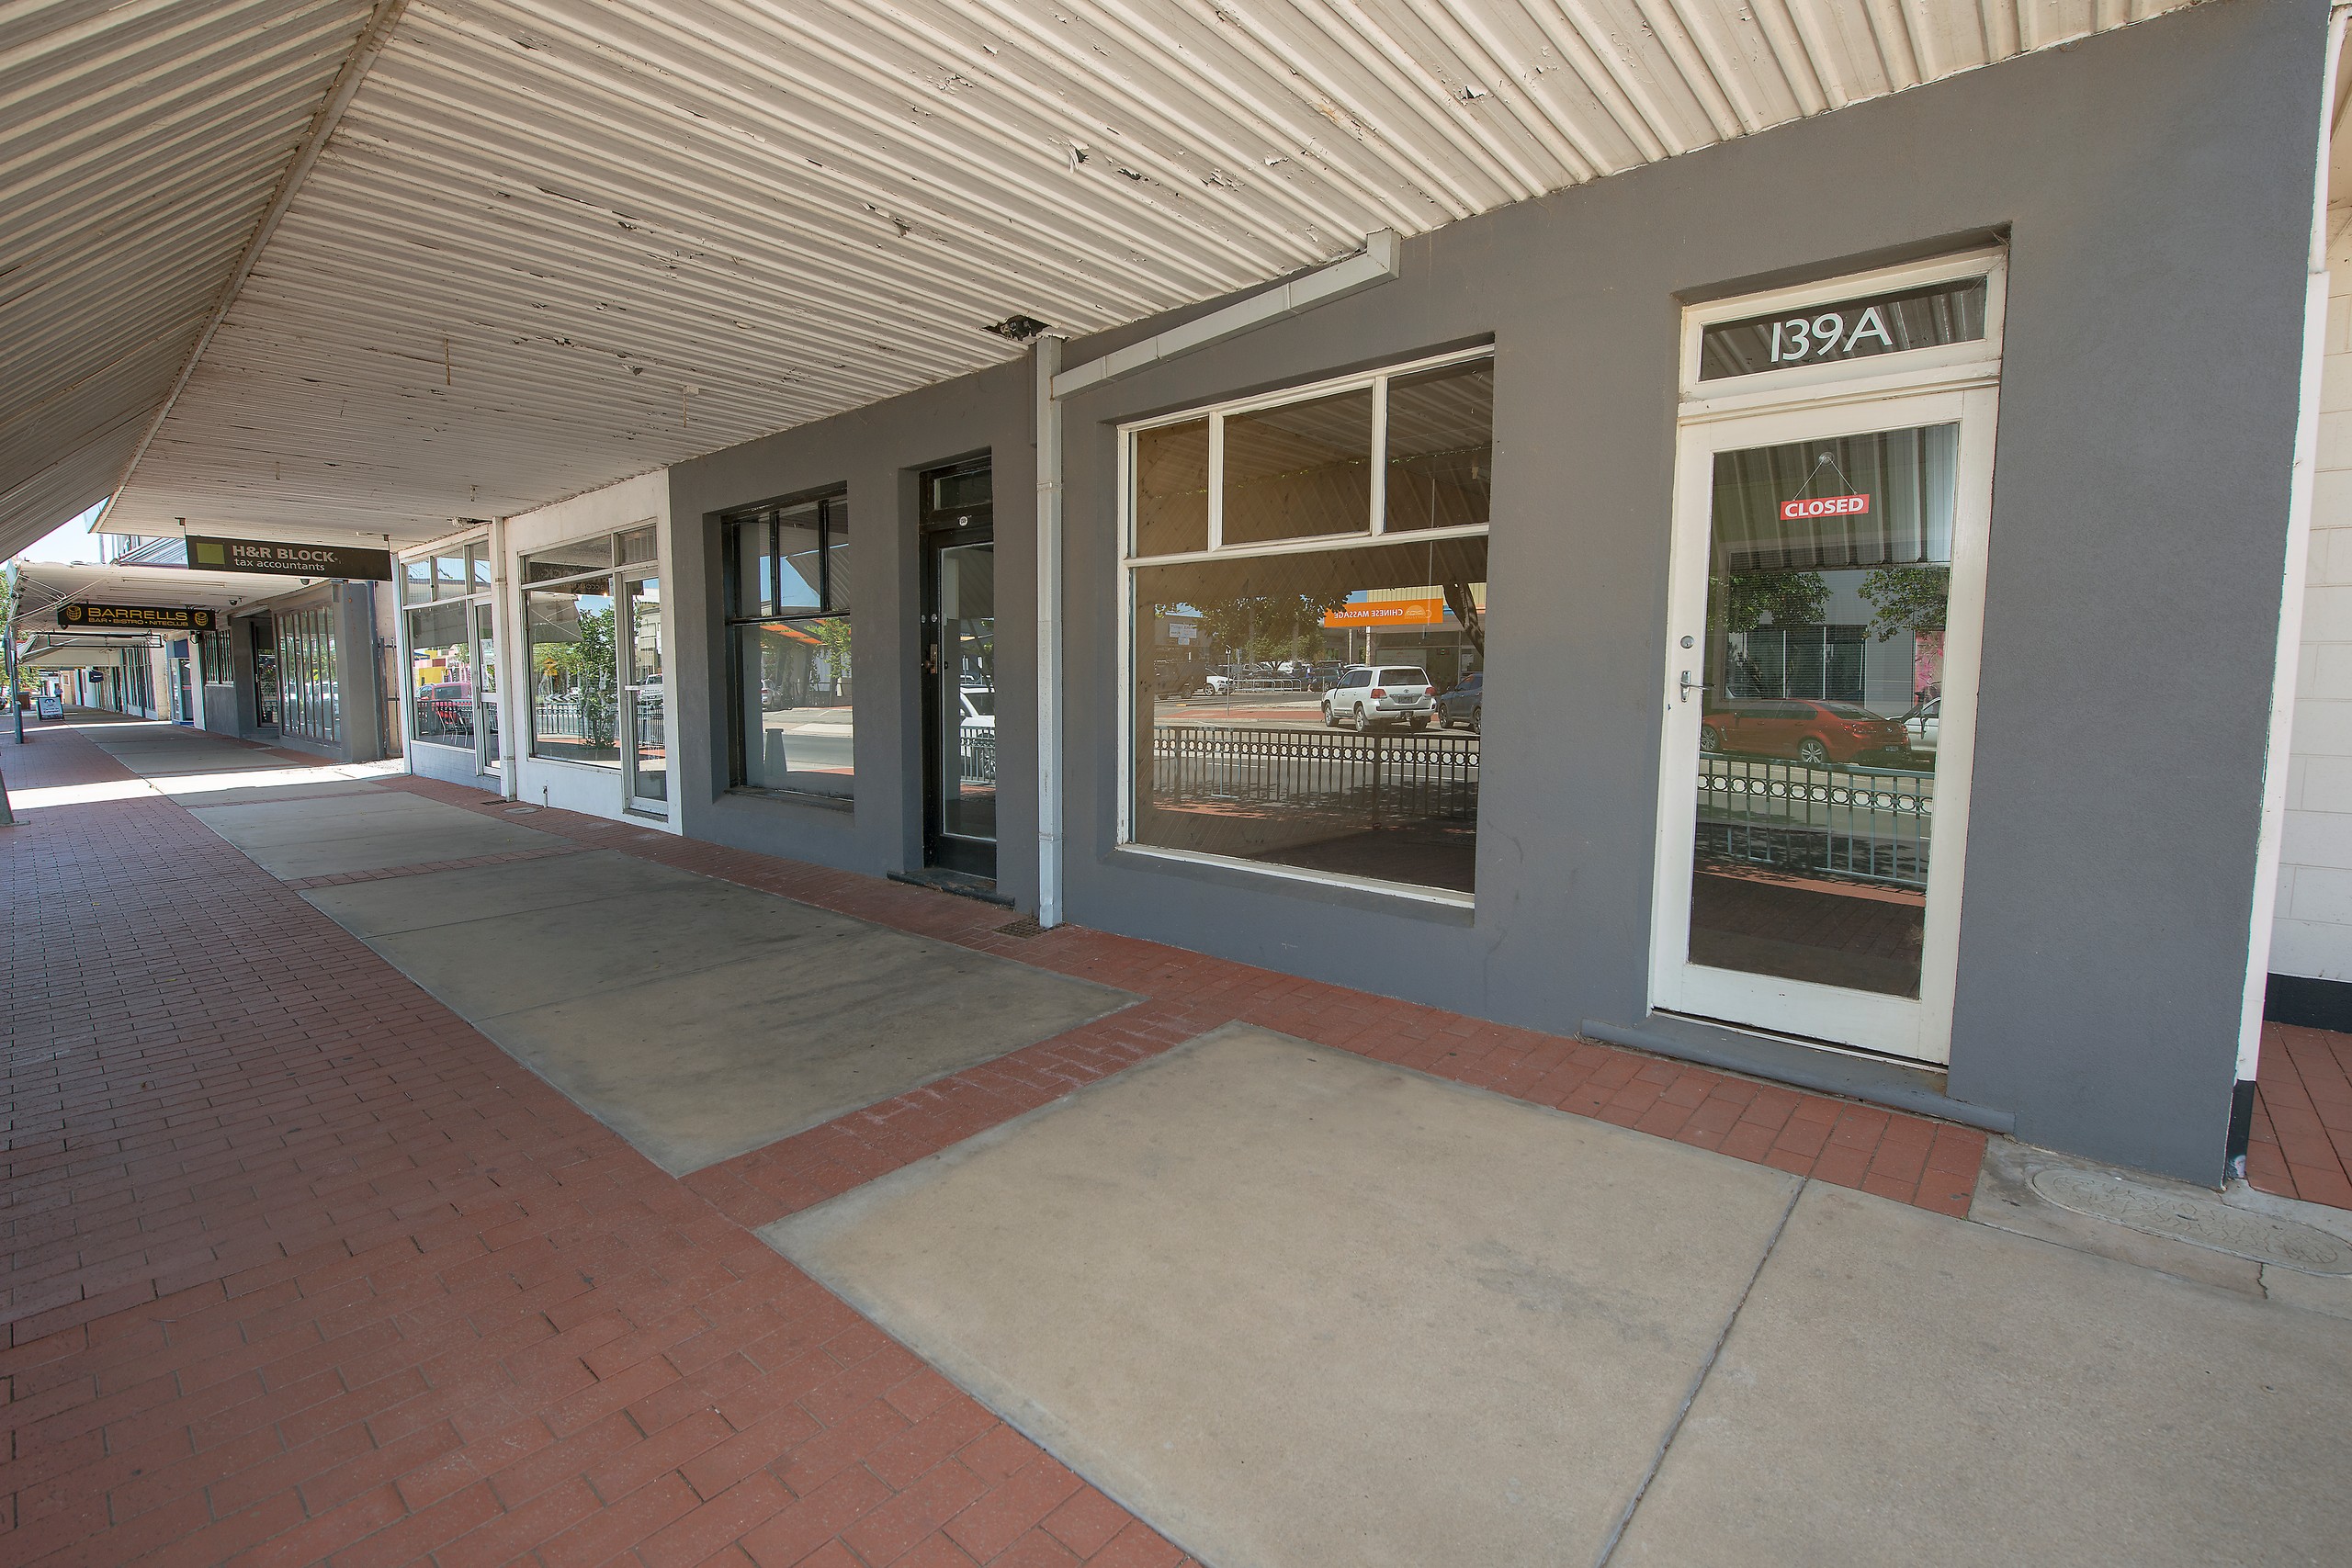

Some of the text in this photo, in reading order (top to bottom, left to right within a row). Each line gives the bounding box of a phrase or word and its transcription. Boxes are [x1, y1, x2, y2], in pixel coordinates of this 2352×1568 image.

[1770, 307, 1893, 363] 139A
[1785, 499, 1863, 517] CLOSED
[232, 546, 335, 562] H&R BLOCK
[256, 560, 325, 570] accountants
[88, 608, 187, 620] BARRELLS
